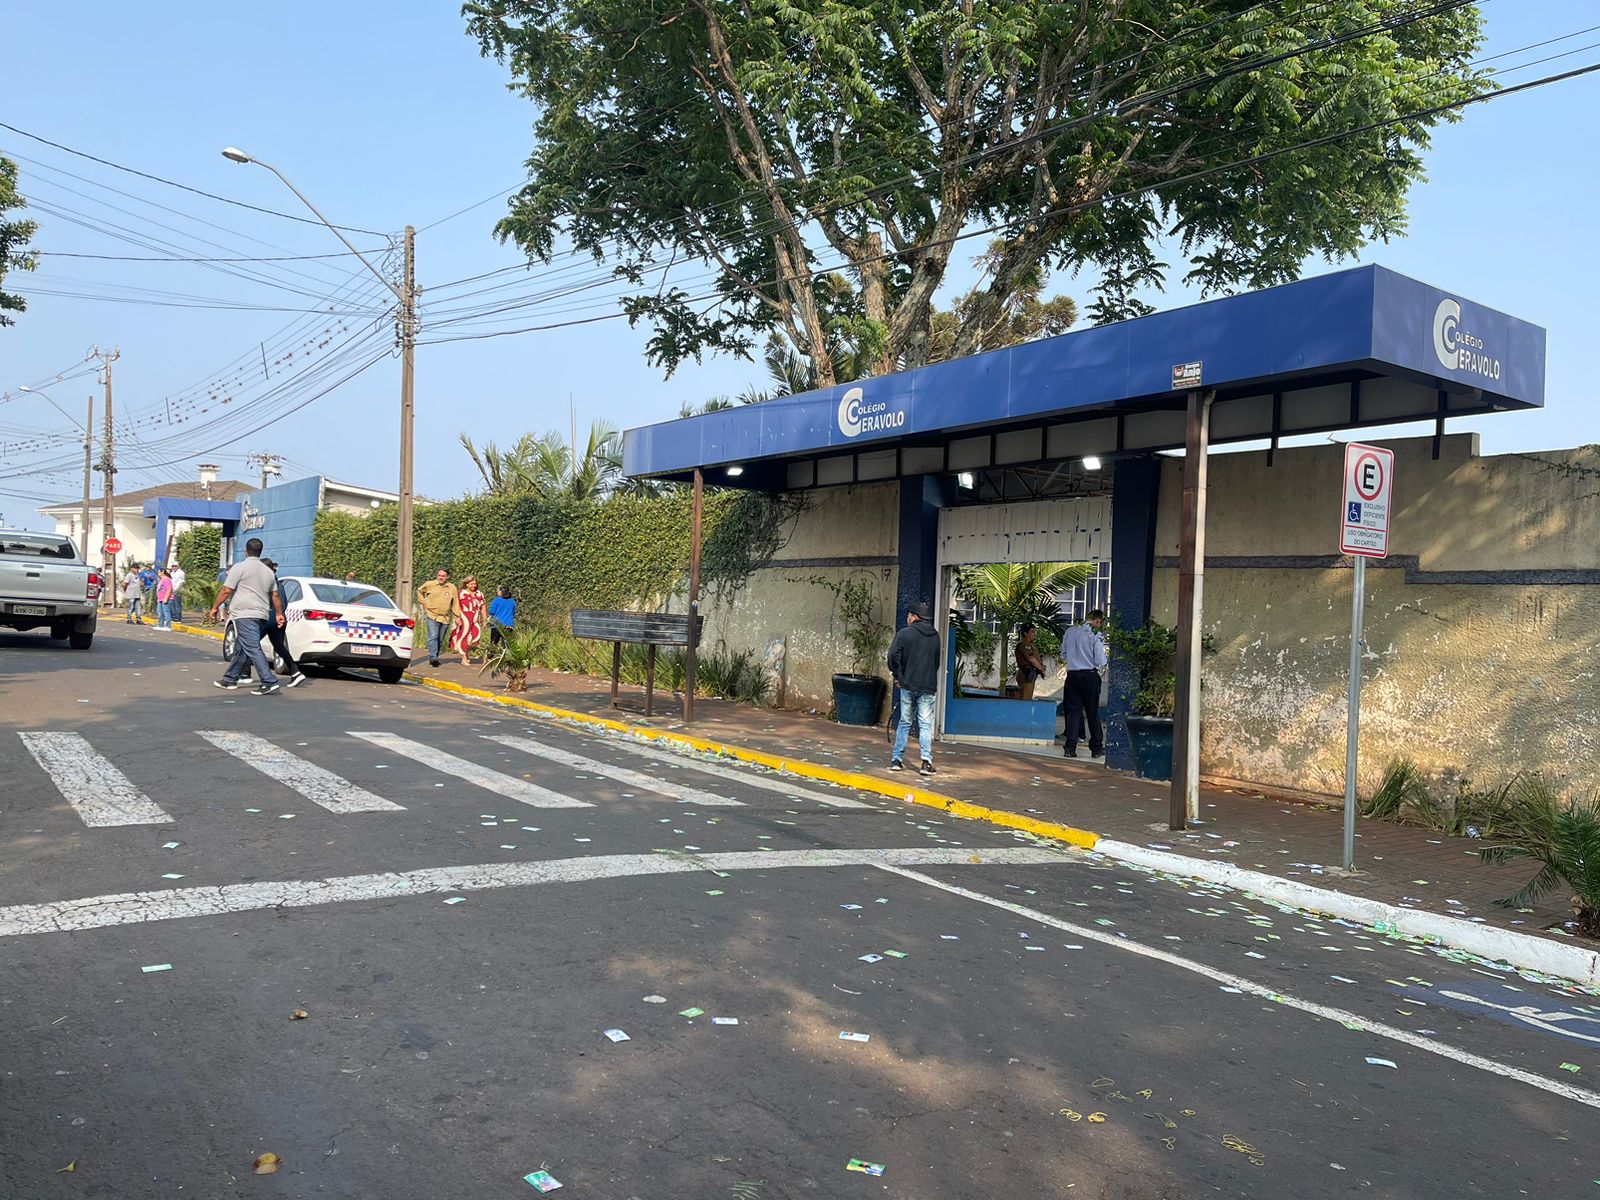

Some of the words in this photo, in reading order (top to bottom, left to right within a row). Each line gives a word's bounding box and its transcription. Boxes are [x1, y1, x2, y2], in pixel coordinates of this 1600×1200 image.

[1363, 464, 1375, 490] E
[1364, 503, 1385, 511] EXCLUSIVO
[1364, 512, 1385, 520] DEFICIENTE
